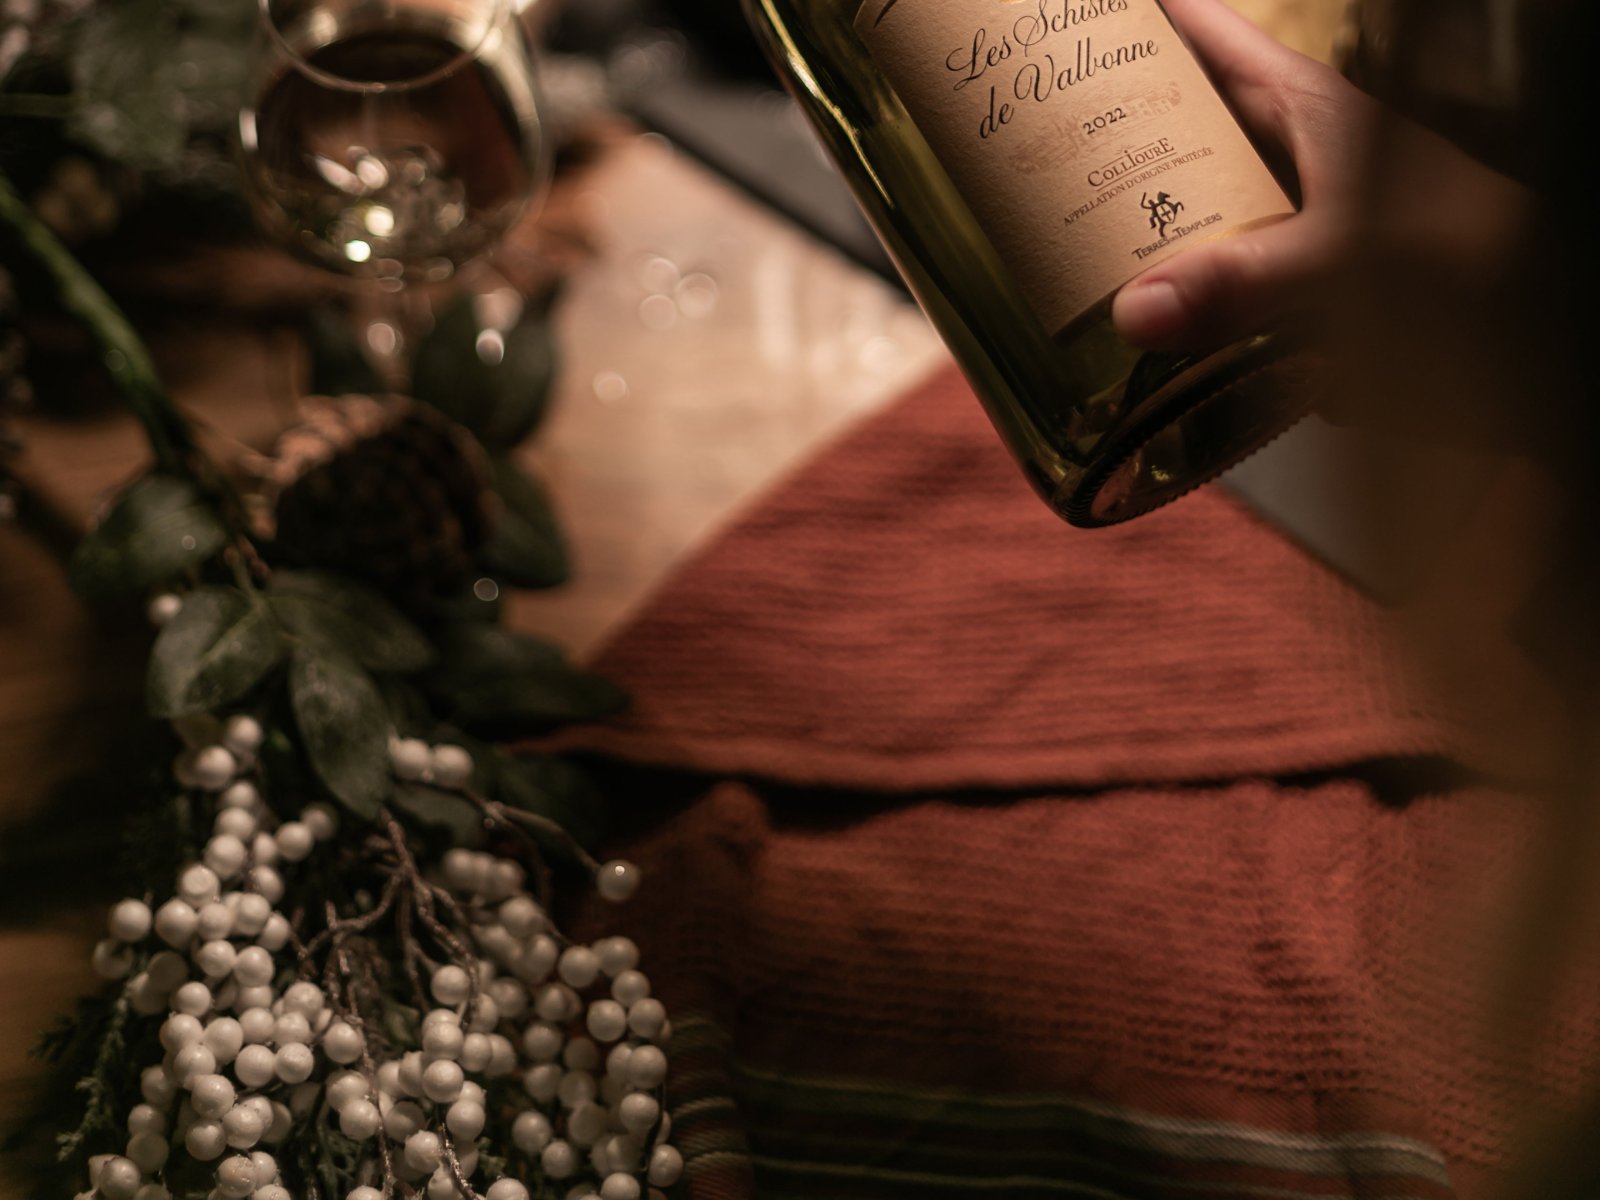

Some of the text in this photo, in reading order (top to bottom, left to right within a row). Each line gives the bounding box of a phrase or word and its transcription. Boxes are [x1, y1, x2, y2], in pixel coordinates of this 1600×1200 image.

[946, 28, 1012, 91] Les
[979, 36, 1159, 139] de Valbonne
[1082, 107, 1127, 135] 2022
[1063, 183, 1127, 227] APPELLATION
[1131, 212, 1223, 260] TERRES TEMPLIERS
